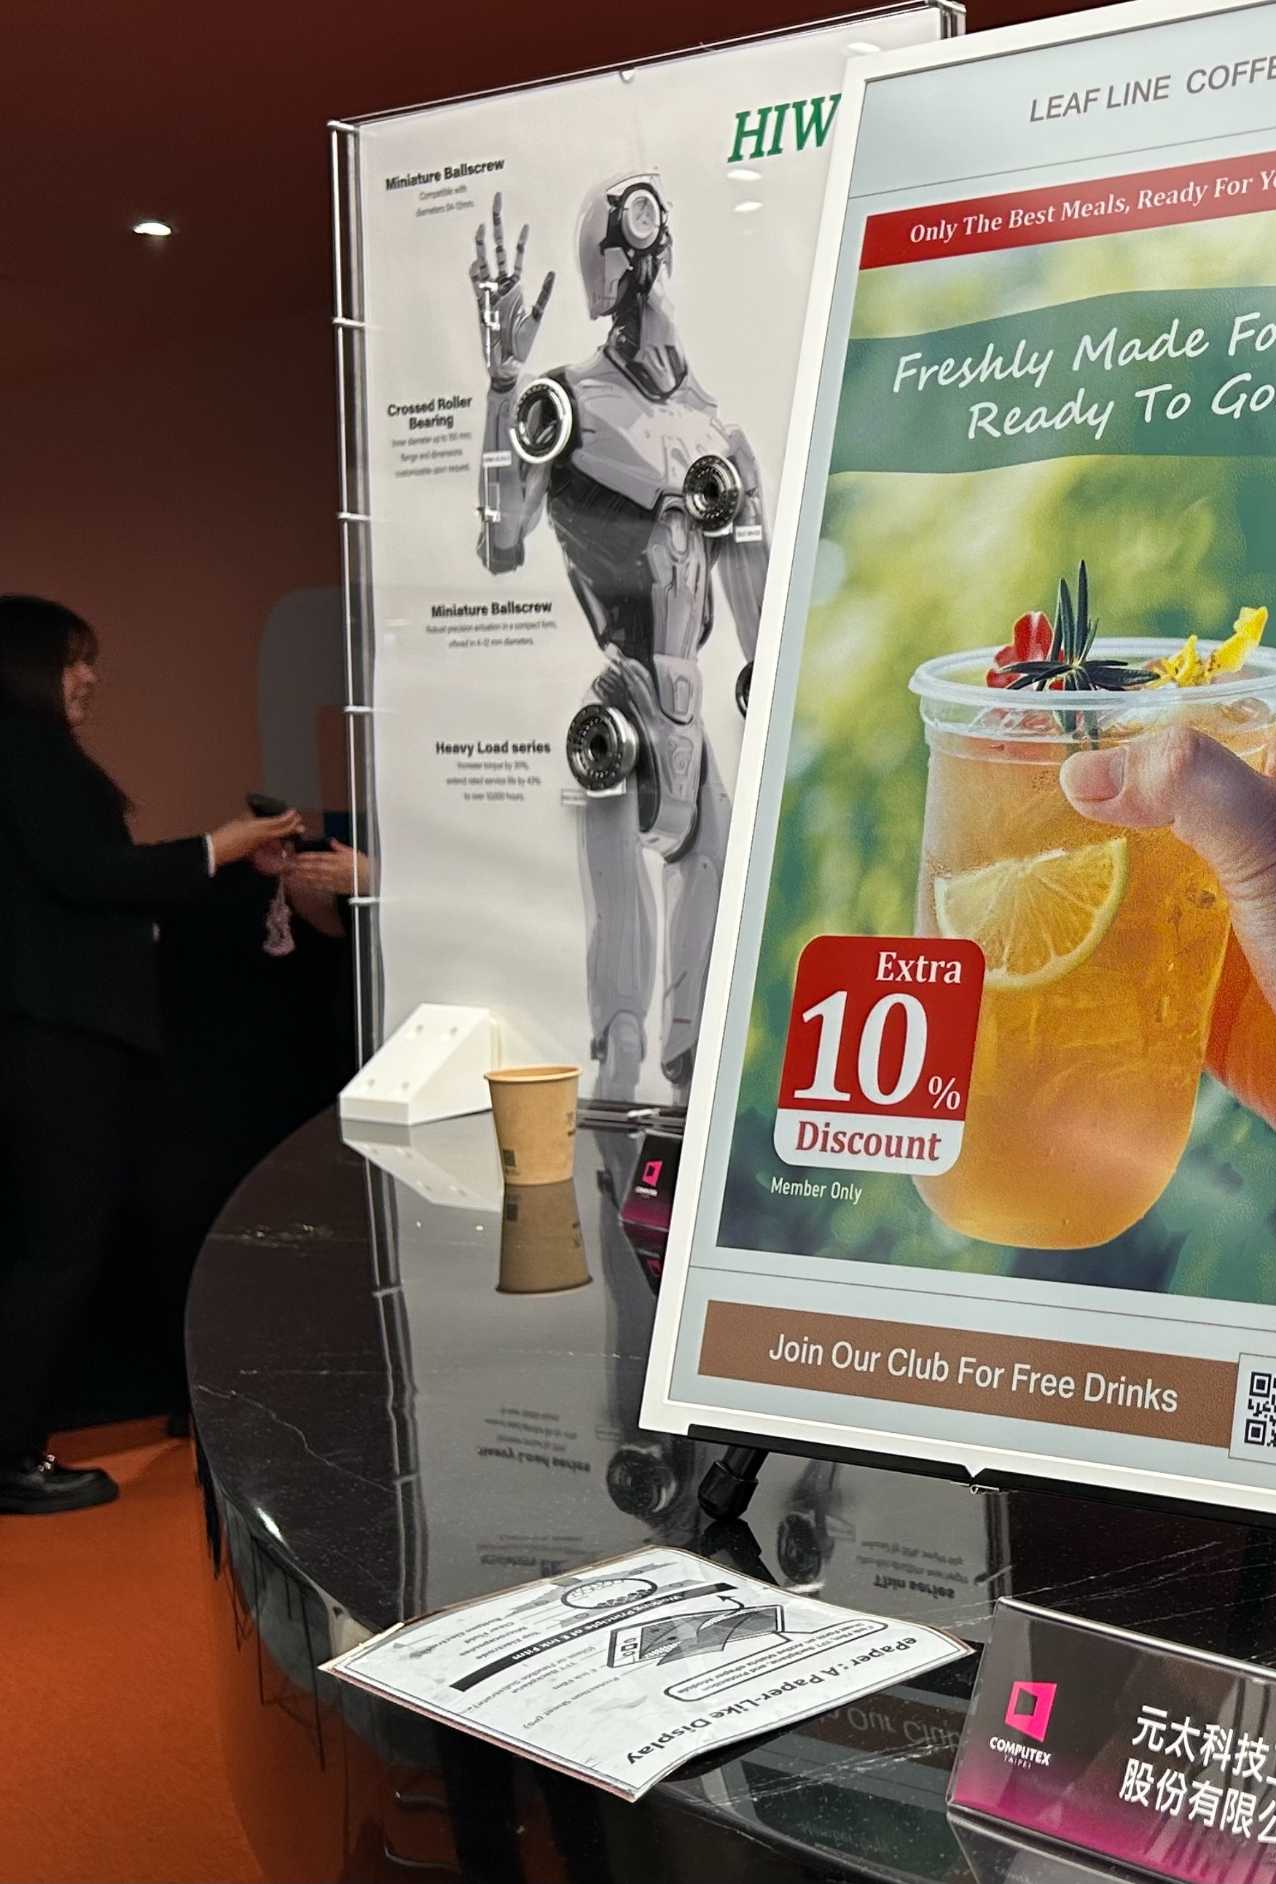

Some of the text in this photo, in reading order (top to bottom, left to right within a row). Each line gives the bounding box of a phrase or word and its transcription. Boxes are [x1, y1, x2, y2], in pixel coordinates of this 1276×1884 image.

[1030, 88, 1101, 122] LEAF
[1106, 75, 1171, 109] LINE
[385, 160, 505, 191] Miniature Ballscrew
[909, 218, 958, 243] Only
[963, 214, 1002, 236] The
[1008, 206, 1055, 229] Best
[1060, 195, 1131, 225] Meals,
[1136, 181, 1207, 211] Ready
[1213, 177, 1253, 199] For
[893, 338, 1054, 393] Freshly
[1072, 318, 1209, 371] Made
[387, 396, 473, 417] Crossed Roller
[967, 387, 1115, 440] Ready
[1135, 383, 1191, 423] To
[409, 415, 454, 430] Bearing
[432, 600, 553, 618] Miniature Ballscrew
[435, 740, 552, 758] Heavy Load series
[875, 951, 962, 984] Extra
[795, 1120, 942, 1161] Discount
[770, 1176, 863, 1205] Member Only
[768, 1333, 1179, 1414] Join Our Club For Free Drinks
[850, 1637, 918, 1667] ePaper
[820, 1666, 841, 1677] A
[712, 1673, 825, 1720] Paper-Like
[627, 1718, 713, 1765] Display
[989, 1736, 1052, 1767] COMPUTEX
[1004, 1754, 1032, 1770] TAIPEI
